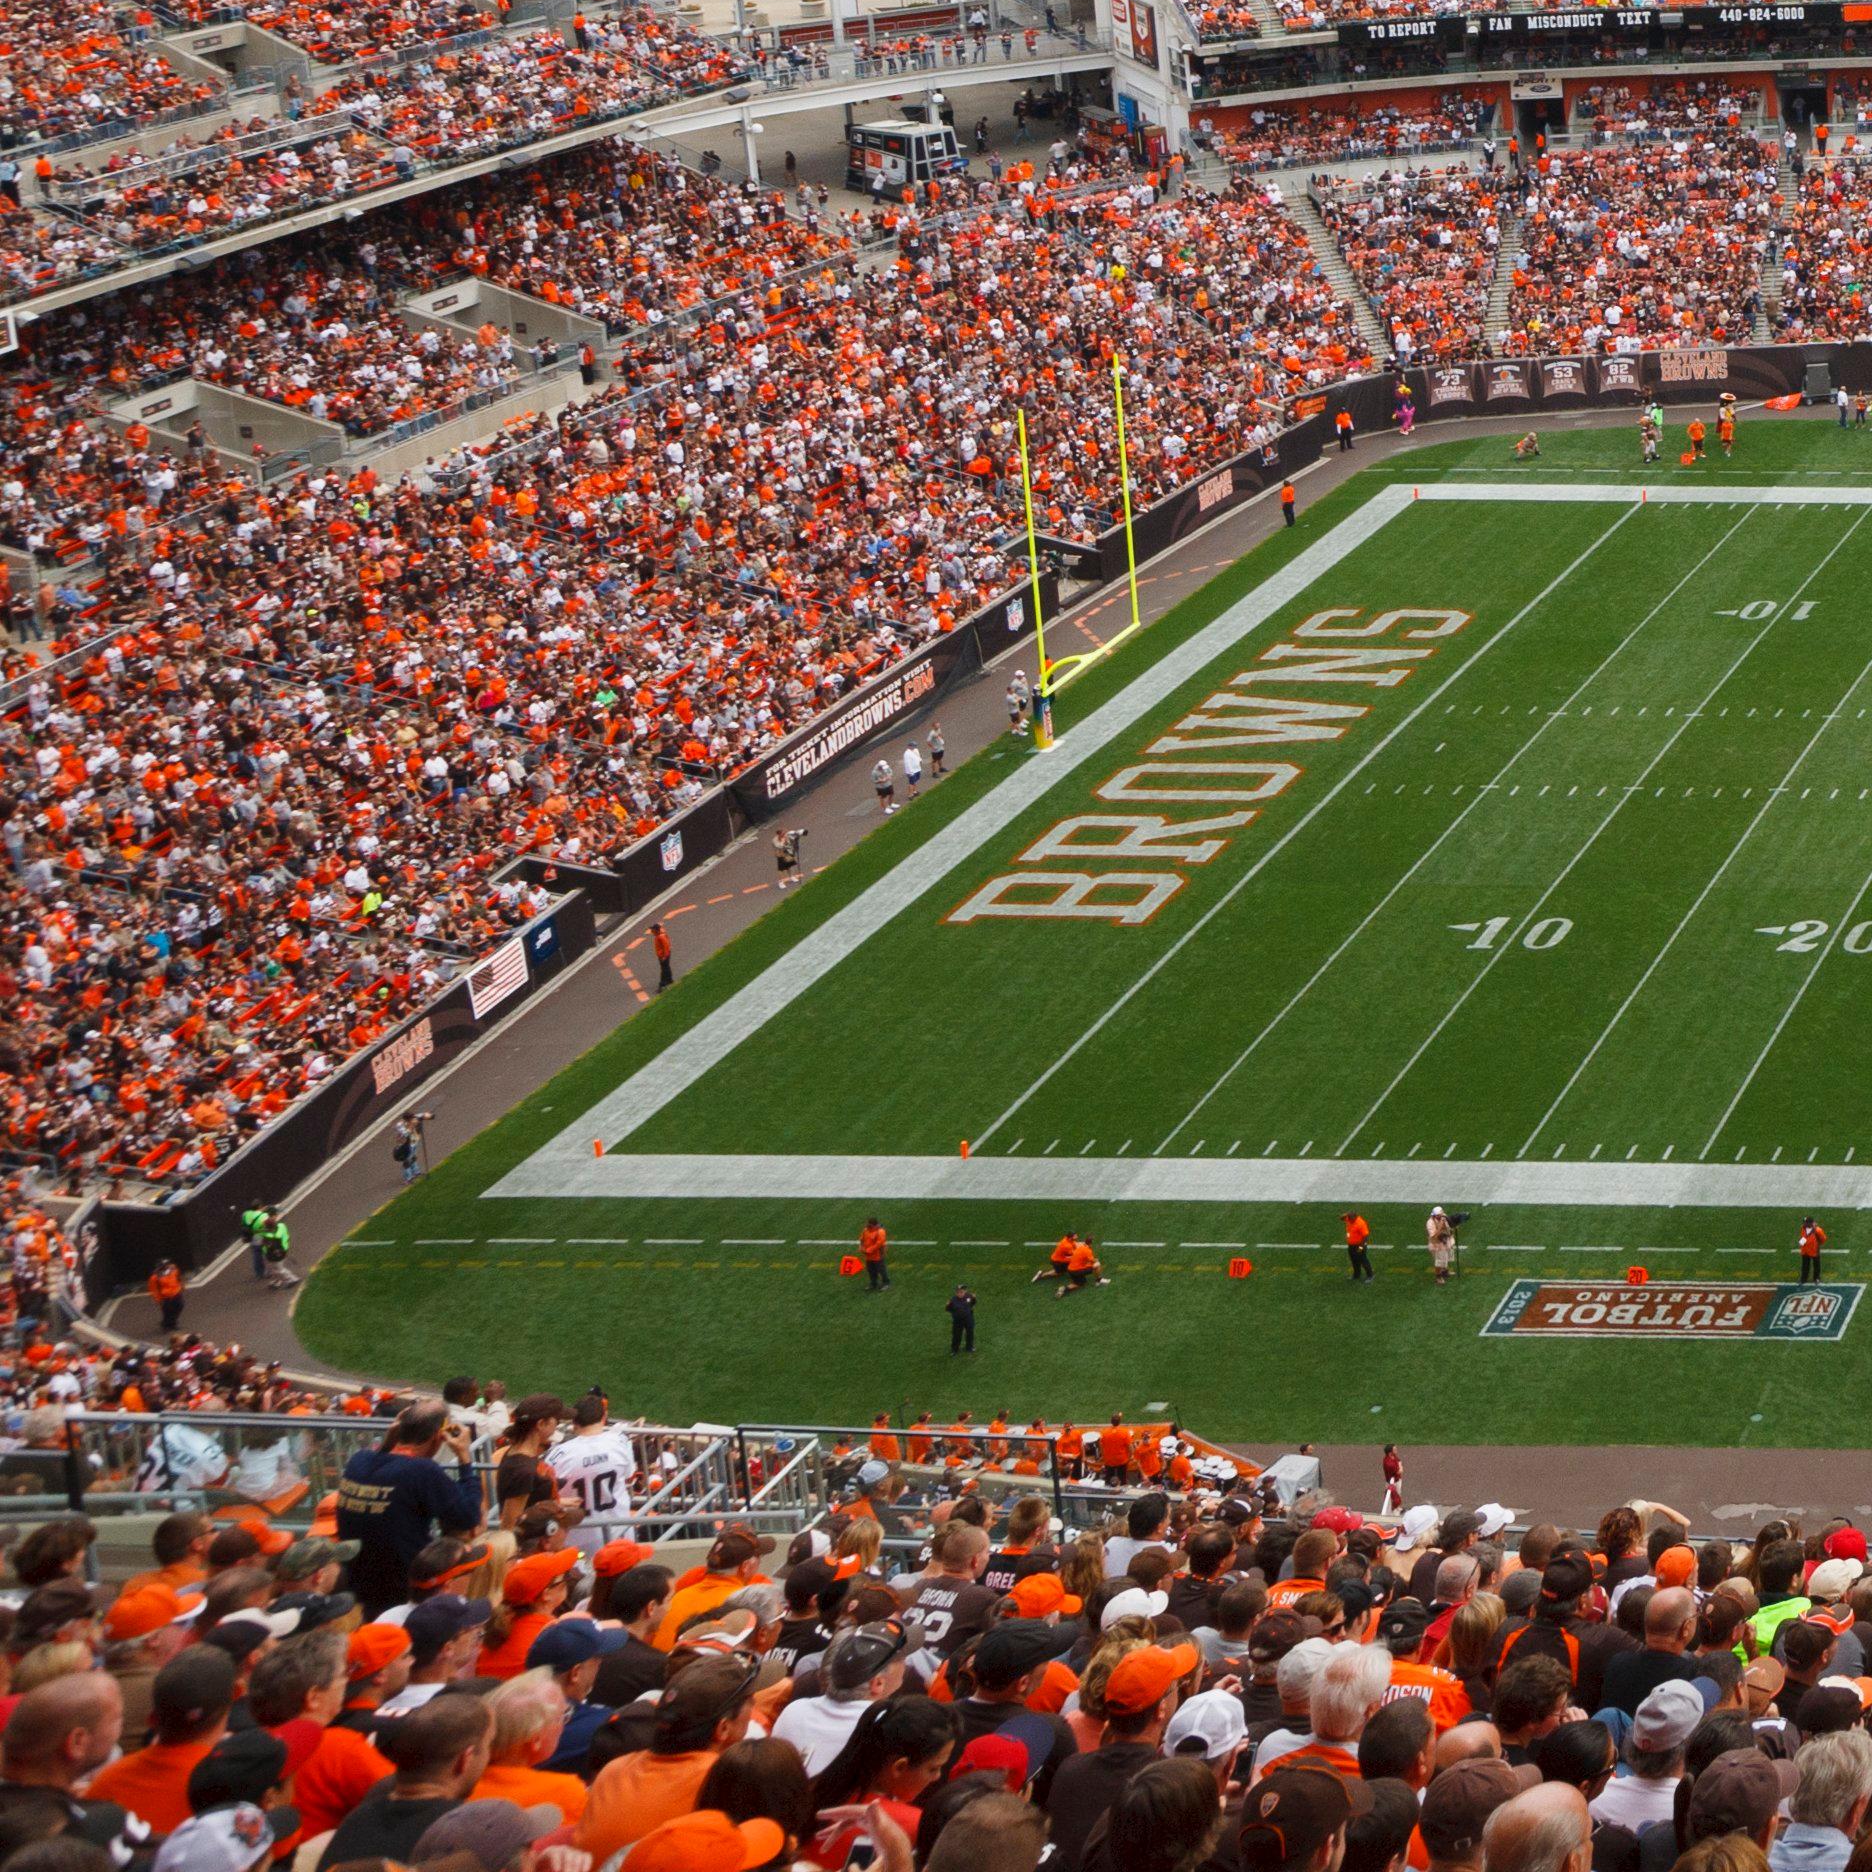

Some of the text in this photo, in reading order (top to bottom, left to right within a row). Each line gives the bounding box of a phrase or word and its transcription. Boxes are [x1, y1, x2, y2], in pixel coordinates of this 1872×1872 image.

[1719, 7, 1805, 21] 440-824-6000
[1368, 12, 1651, 39] TO REPORT FAN MISCONDUCT TEXT
[1660, 351, 1728, 365] CLEVELAND
[1553, 367, 1573, 378] 53
[1606, 375, 1634, 385] AFWB
[1609, 364, 1629, 376] 82
[1660, 363, 1729, 382] BROWNS
[1441, 375, 1460, 386] 73
[1739, 600, 1820, 620] 10
[788, 728, 829, 760] TICKET
[830, 677, 902, 732] INFORMATION
[902, 658, 932, 682] VISIT
[766, 666, 936, 800] CLEVELANDBROWNS.COM
[940, 608, 1474, 925] BROWNS
[1465, 916, 1574, 950] 10
[1575, 1290, 1747, 1305] AMERICANO
[1787, 1295, 1834, 1315] NFL
[1496, 1290, 1533, 1326] 2013
[1542, 1301, 1754, 1330] FÚTBOL
[582, 1454, 609, 1467] QUINN
[567, 1470, 618, 1516] 10
[917, 1587, 960, 1608] BROWN
